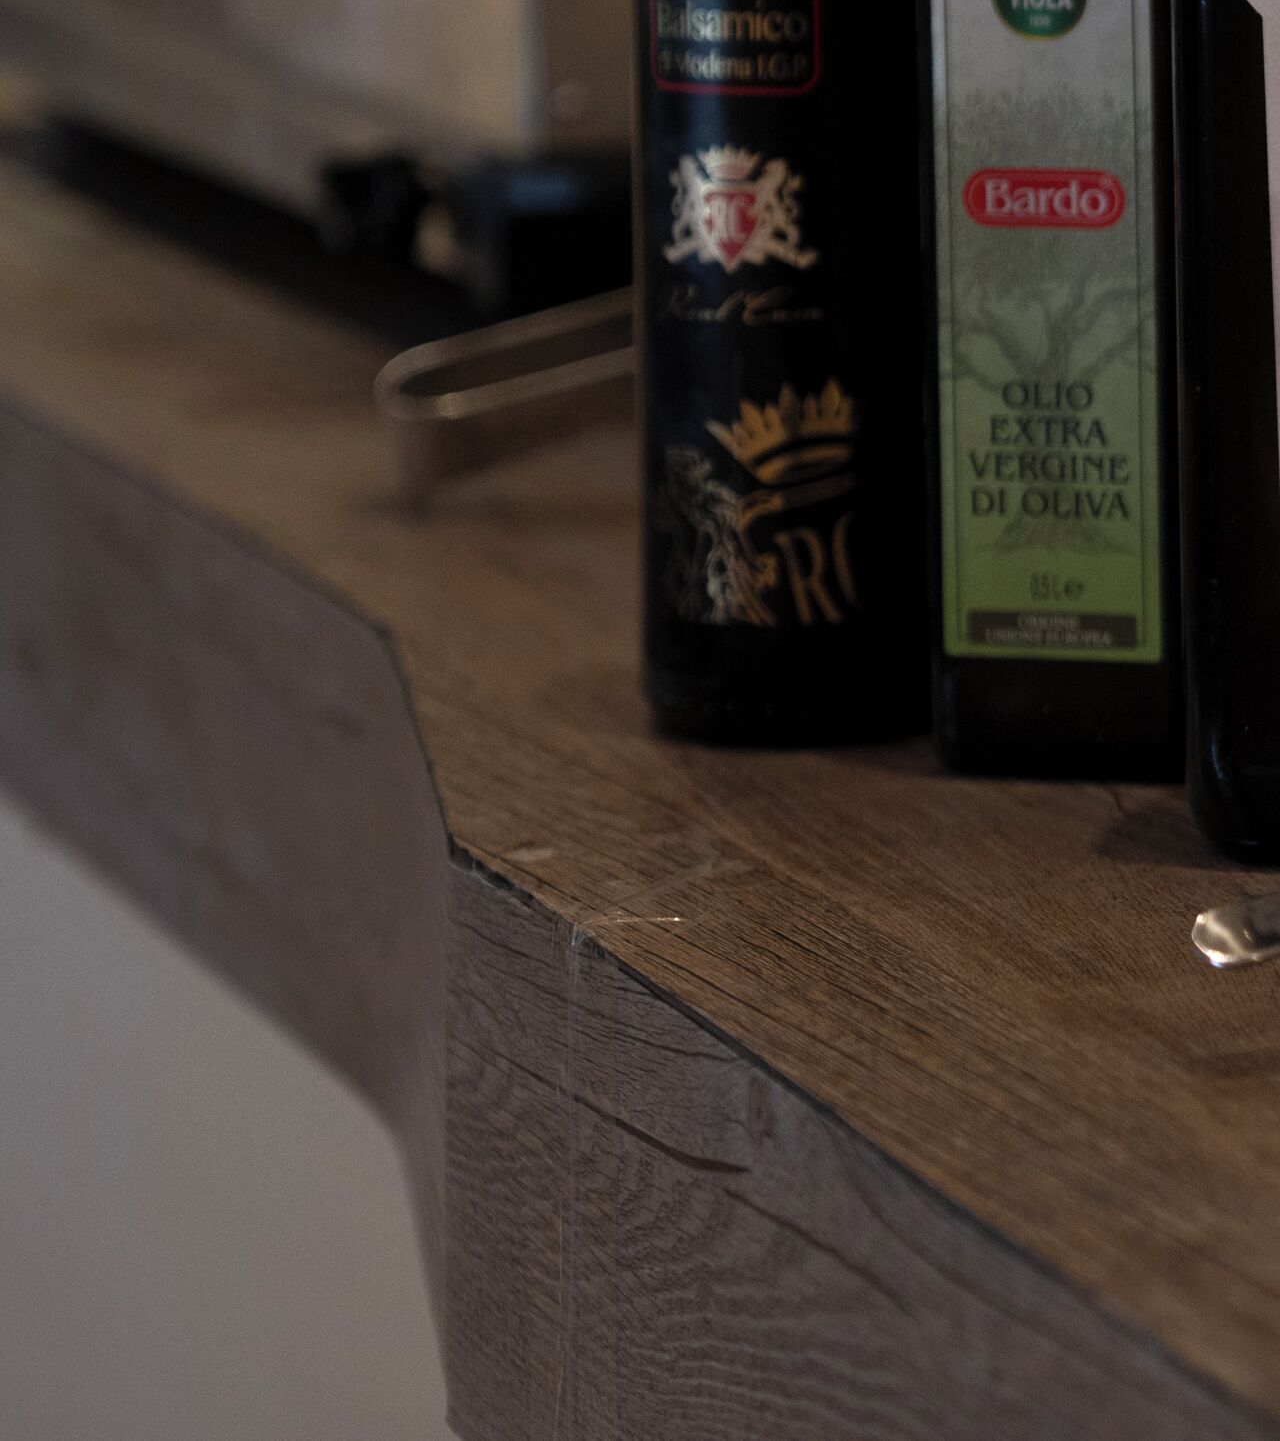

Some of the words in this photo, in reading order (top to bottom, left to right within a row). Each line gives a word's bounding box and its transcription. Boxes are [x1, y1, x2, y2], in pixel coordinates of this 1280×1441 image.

[984, 177, 1109, 219] Bardo
[1001, 379, 1094, 412] OLIO
[989, 415, 1108, 448] EXTRA
[968, 450, 1130, 485] VERGINE
[970, 487, 1006, 518] DI
[1020, 486, 1130, 520] OLIVA
